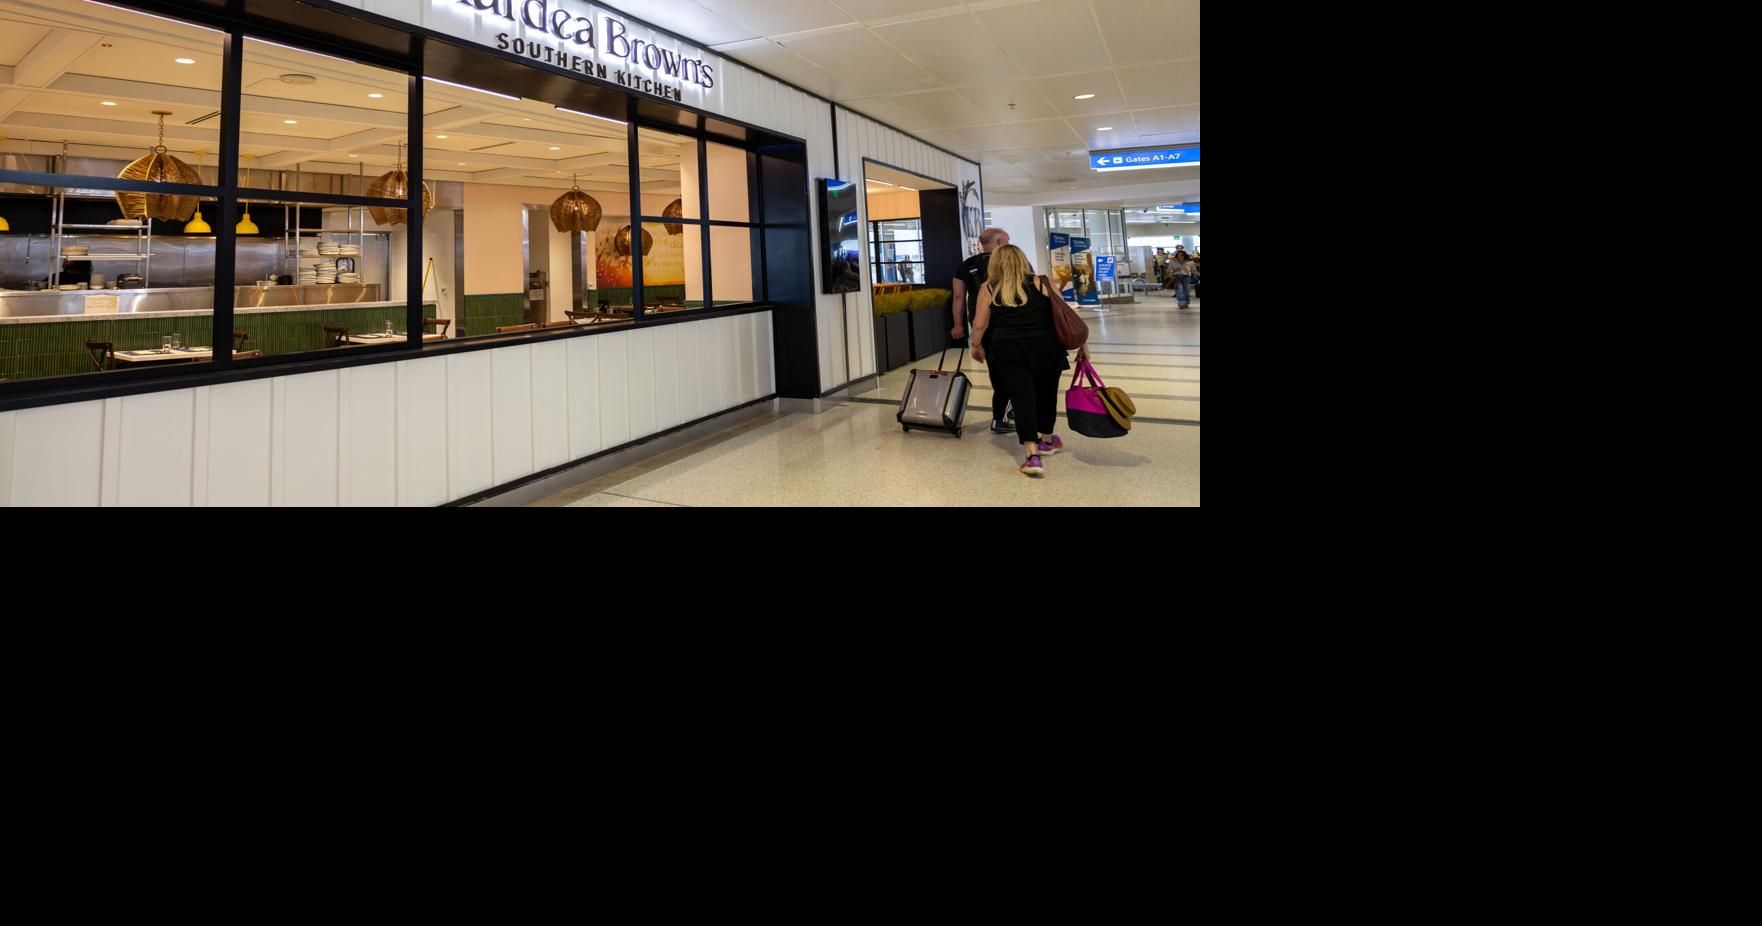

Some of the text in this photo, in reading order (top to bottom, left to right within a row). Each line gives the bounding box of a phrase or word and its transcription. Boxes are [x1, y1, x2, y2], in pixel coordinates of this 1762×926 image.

[456, 0, 714, 89] rdea Brown's
[497, 33, 682, 102] SOUTHERN KITCHEN
[1152, 153, 1181, 161] A1-A7
